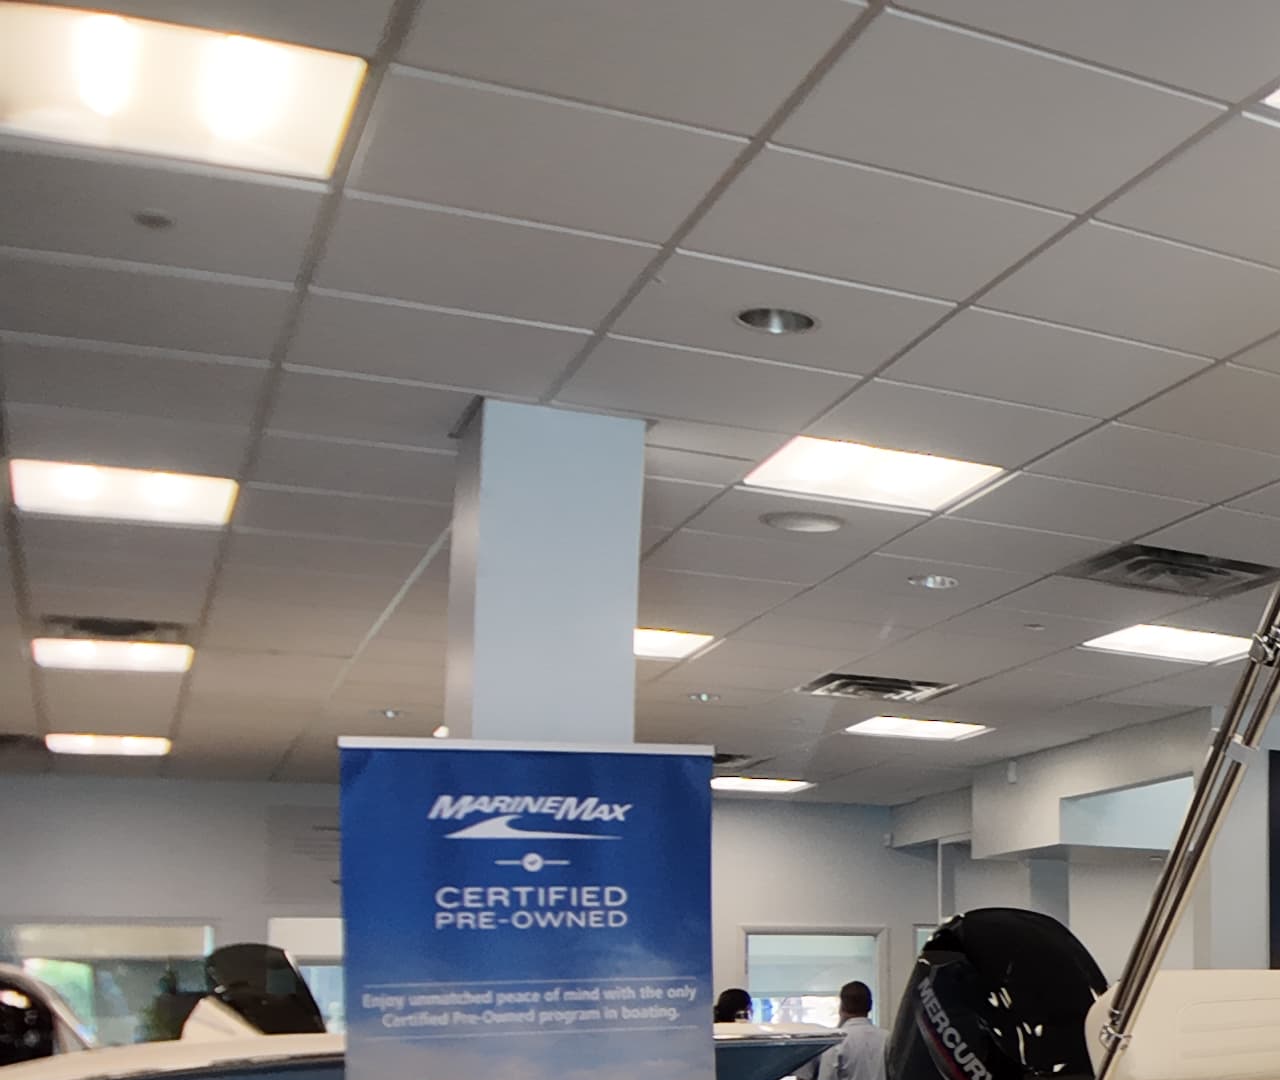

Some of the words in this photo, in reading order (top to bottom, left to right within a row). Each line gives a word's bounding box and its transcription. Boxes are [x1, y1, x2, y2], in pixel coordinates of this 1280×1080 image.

[435, 886, 628, 910] CERTIFIED
[435, 911, 628, 930] PRE-OWNED
[362, 993, 405, 1011] Enjoy
[408, 991, 493, 1006] unmatched
[496, 990, 540, 1007] peace
[543, 987, 561, 1002] of
[563, 987, 599, 1001] mind
[603, 985, 636, 1000] with
[640, 985, 663, 1000] the
[666, 984, 697, 1001] only
[382, 1011, 449, 1028] Certified
[452, 1009, 535, 1025] Pre-Owned
[539, 1008, 601, 1025] program
[604, 1006, 618, 1020] in
[621, 1004, 680, 1021] boating.
